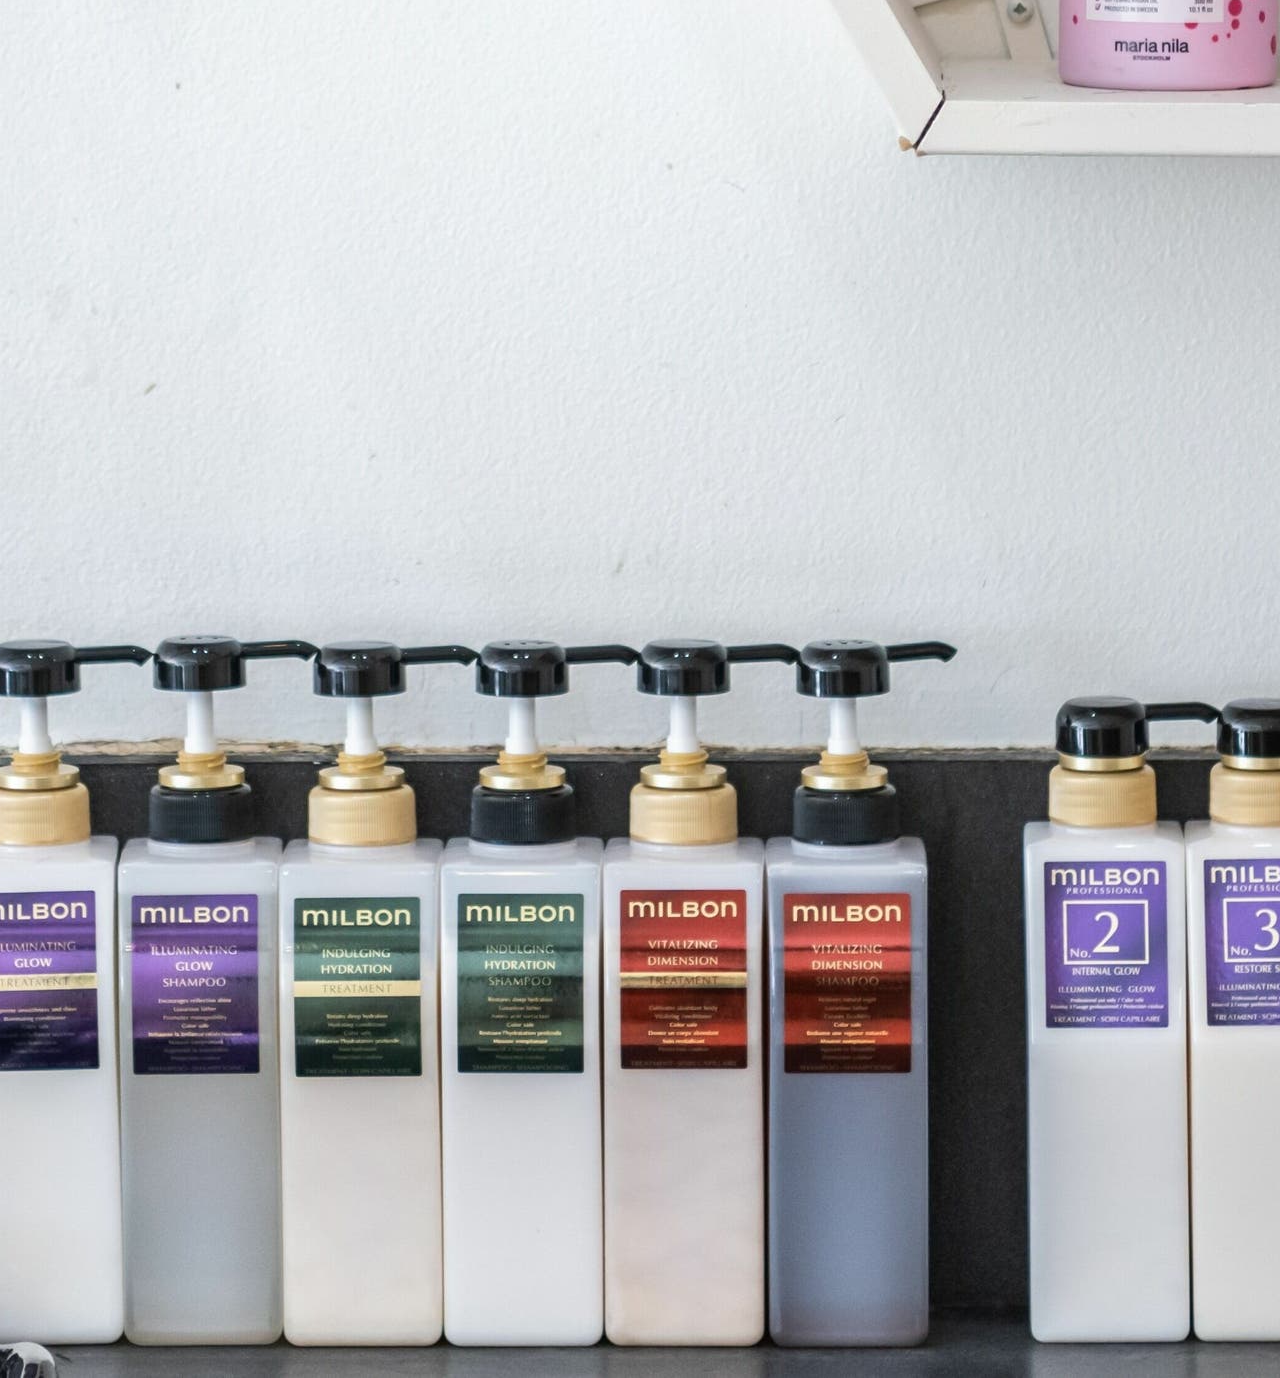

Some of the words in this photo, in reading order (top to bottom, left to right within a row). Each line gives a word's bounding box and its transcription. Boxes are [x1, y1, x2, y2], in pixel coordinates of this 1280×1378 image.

[1115, 38, 1158, 52] maria
[1162, 39, 1189, 52] nila
[1070, 948, 1091, 958] No.
[1093, 911, 1120, 953] 2
[1231, 946, 1251, 955] No.
[1254, 908, 1280, 951] 3
[486, 944, 555, 954] INDULGING
[648, 940, 719, 950] VITALIZING
[812, 944, 882, 954] VITALIZING
[151, 945, 237, 956] ILLUMINATING
[322, 948, 391, 959] INDULGING
[14, 958, 52, 968] GLOW
[484, 960, 556, 970] HYDRATION
[647, 956, 719, 966] DIMENSION
[811, 960, 883, 970] DIMENSION
[175, 961, 213, 972] GLOW
[321, 964, 392, 974] HYDRATION
[1072, 967, 1112, 976] INTERNAL
[1114, 967, 1140, 976] GLOW
[1235, 964, 1273, 973] RESTORE
[0, 977, 69, 988] TREATMENT
[162, 977, 226, 988] SHAMPOO
[488, 976, 552, 986] SHAMPOO
[649, 976, 719, 985] TREATMENT
[816, 976, 879, 986] SHAMPOO
[320, 984, 392, 993] TREATMENT
[1058, 985, 1122, 993] ILLUMINATING
[1128, 985, 1155, 993] GLOW
